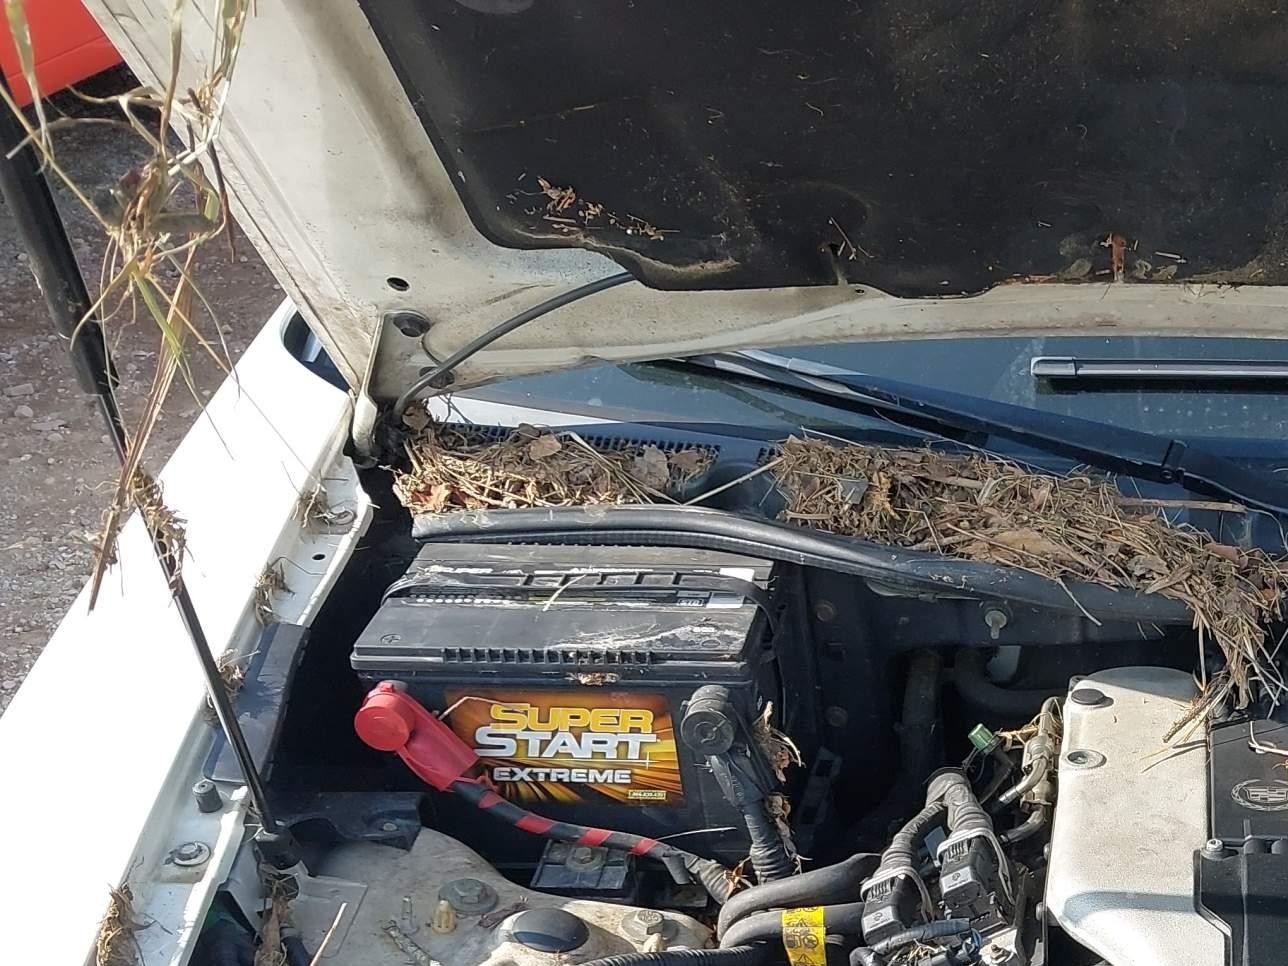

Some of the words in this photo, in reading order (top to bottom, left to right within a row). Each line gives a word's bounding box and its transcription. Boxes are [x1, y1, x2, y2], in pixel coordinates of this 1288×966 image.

[490, 703, 655, 733] SUPER
[474, 726, 658, 759] START
[493, 767, 631, 784] EXTREME
